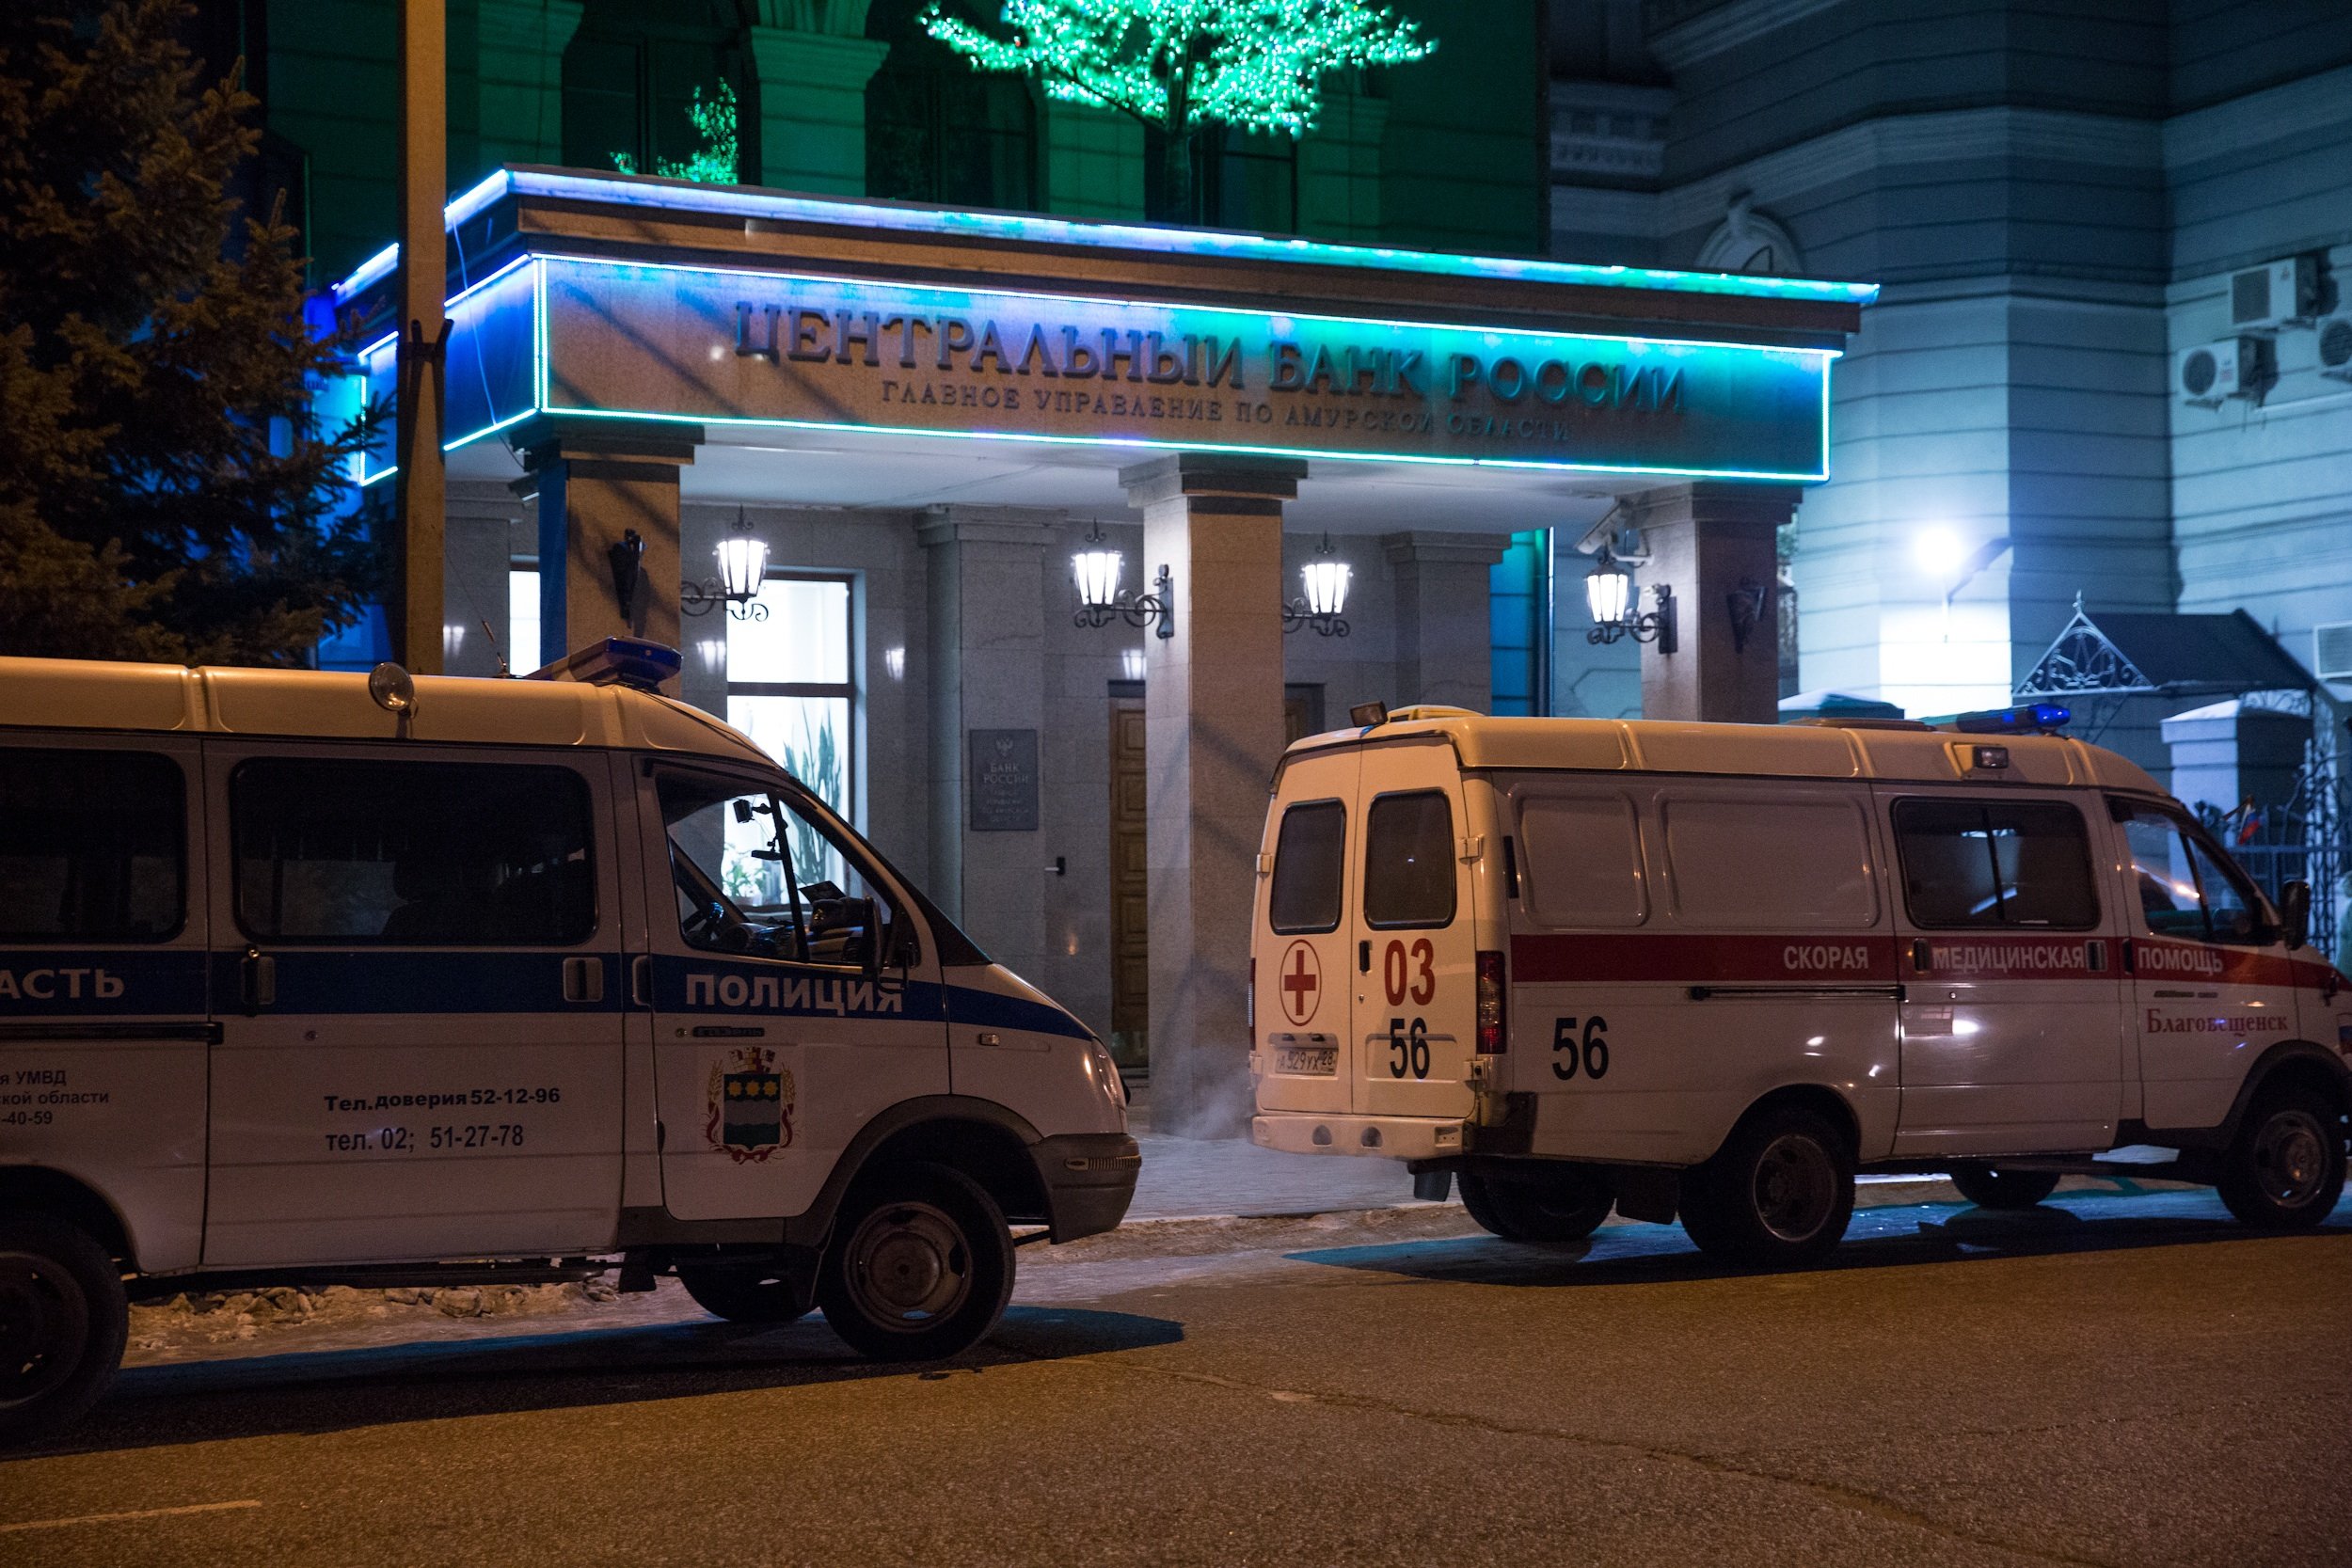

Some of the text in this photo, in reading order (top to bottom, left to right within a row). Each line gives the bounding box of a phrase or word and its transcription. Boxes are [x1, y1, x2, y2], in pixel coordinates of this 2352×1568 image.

[1268, 340, 1425, 399] БАНК
[1449, 352, 1688, 414] РОССИИ
[882, 380, 1021, 409] ГЛАВНОЕ
[1036, 388, 1223, 421] УПРАВЛЕНИЕ
[1235, 402, 1272, 423] ПО
[1445, 413, 1569, 440] ОБЛАСТИ
[991, 763, 1019, 772] БАНК
[1383, 938, 1436, 1006] 03
[1784, 944, 2222, 975] СКОРАЯ МЕДИЦИНСКАЯ ПОМОЩЬ
[0, 969, 125, 999] АСТЬ
[686, 974, 903, 1016] ПОЛИЦИЯ
[2146, 1007, 2288, 1037] Благовещенск
[1389, 1017, 1430, 1080] 56
[1551, 1015, 1609, 1081] 56
[15, 1070, 67, 1086] УМВД
[0, 1090, 110, 1105] кой области
[470, 1088, 560, 1104] 52-12-96
[326, 1125, 524, 1153] тел. 02; 51-27-78
